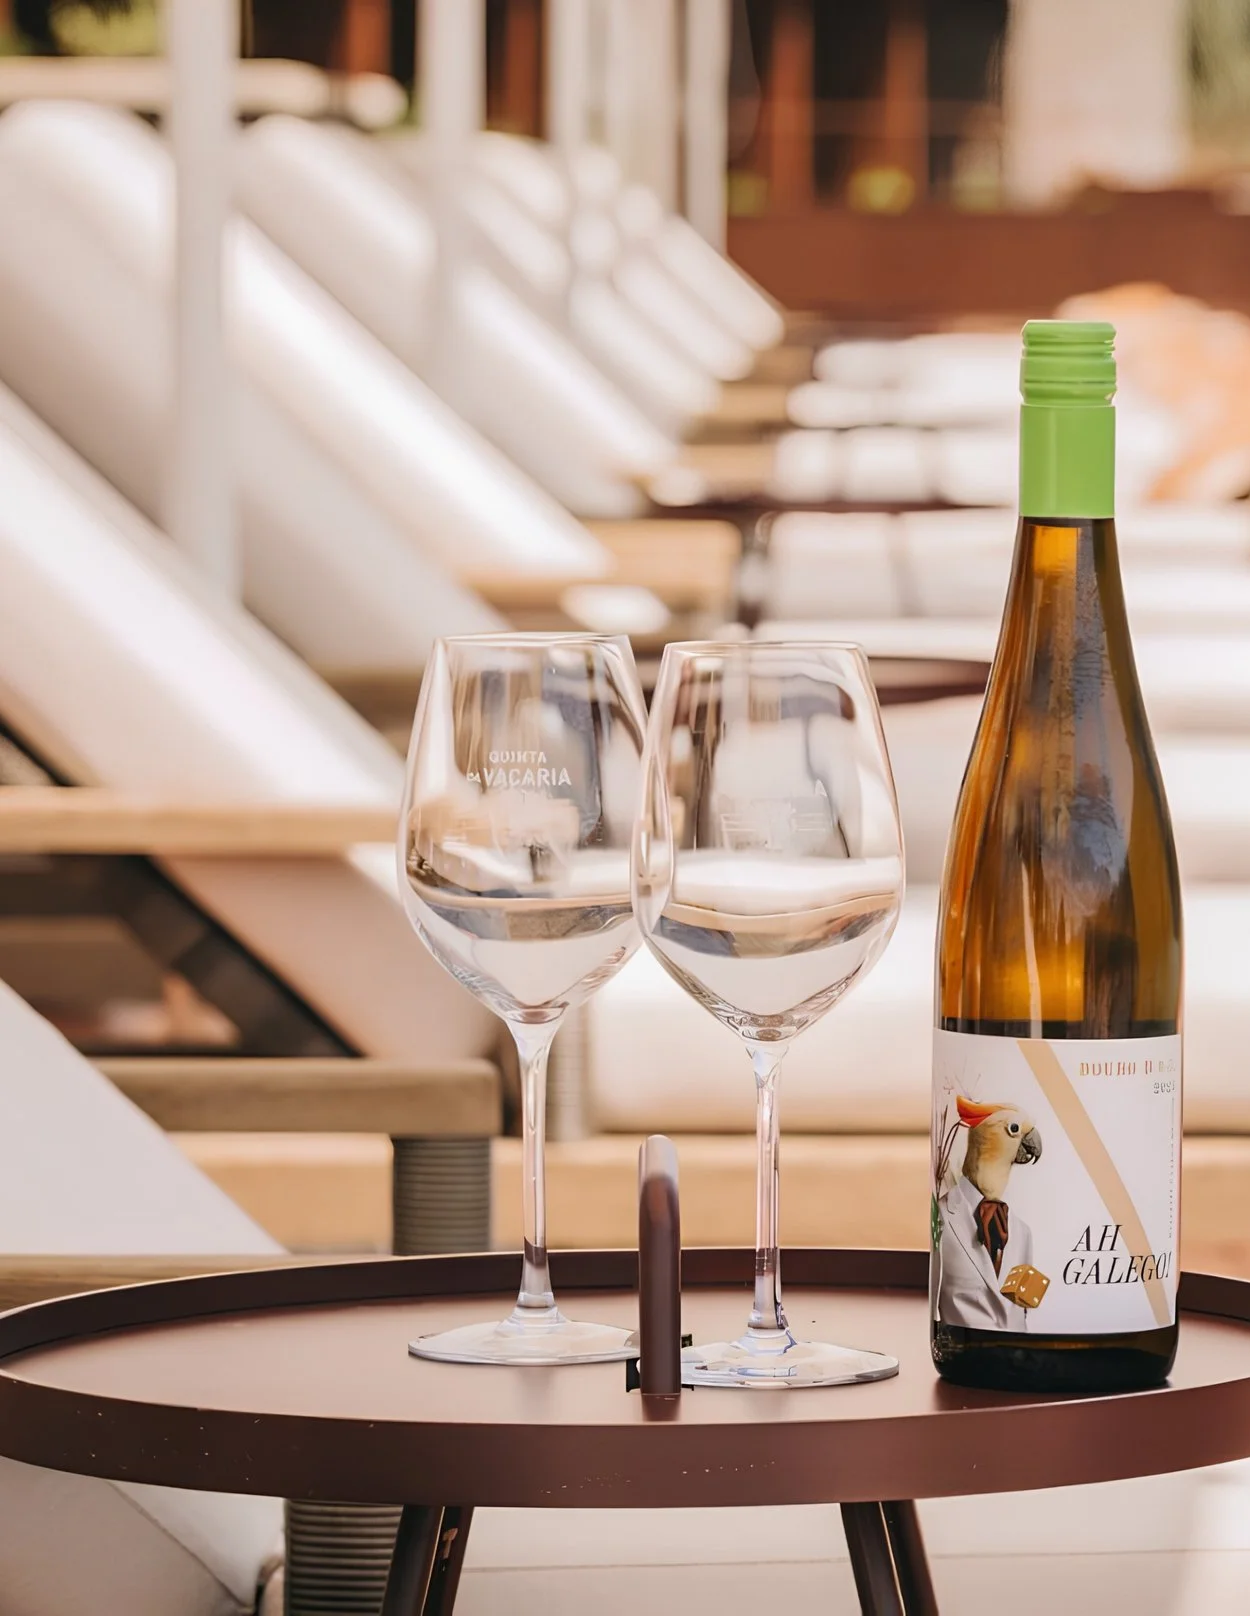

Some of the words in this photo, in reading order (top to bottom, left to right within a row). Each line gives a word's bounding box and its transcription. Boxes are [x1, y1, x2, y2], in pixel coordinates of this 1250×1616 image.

[483, 767, 572, 787] VACARIA
[1070, 1224, 1123, 1252] AH
[1062, 1251, 1172, 1285] GALEGO!
